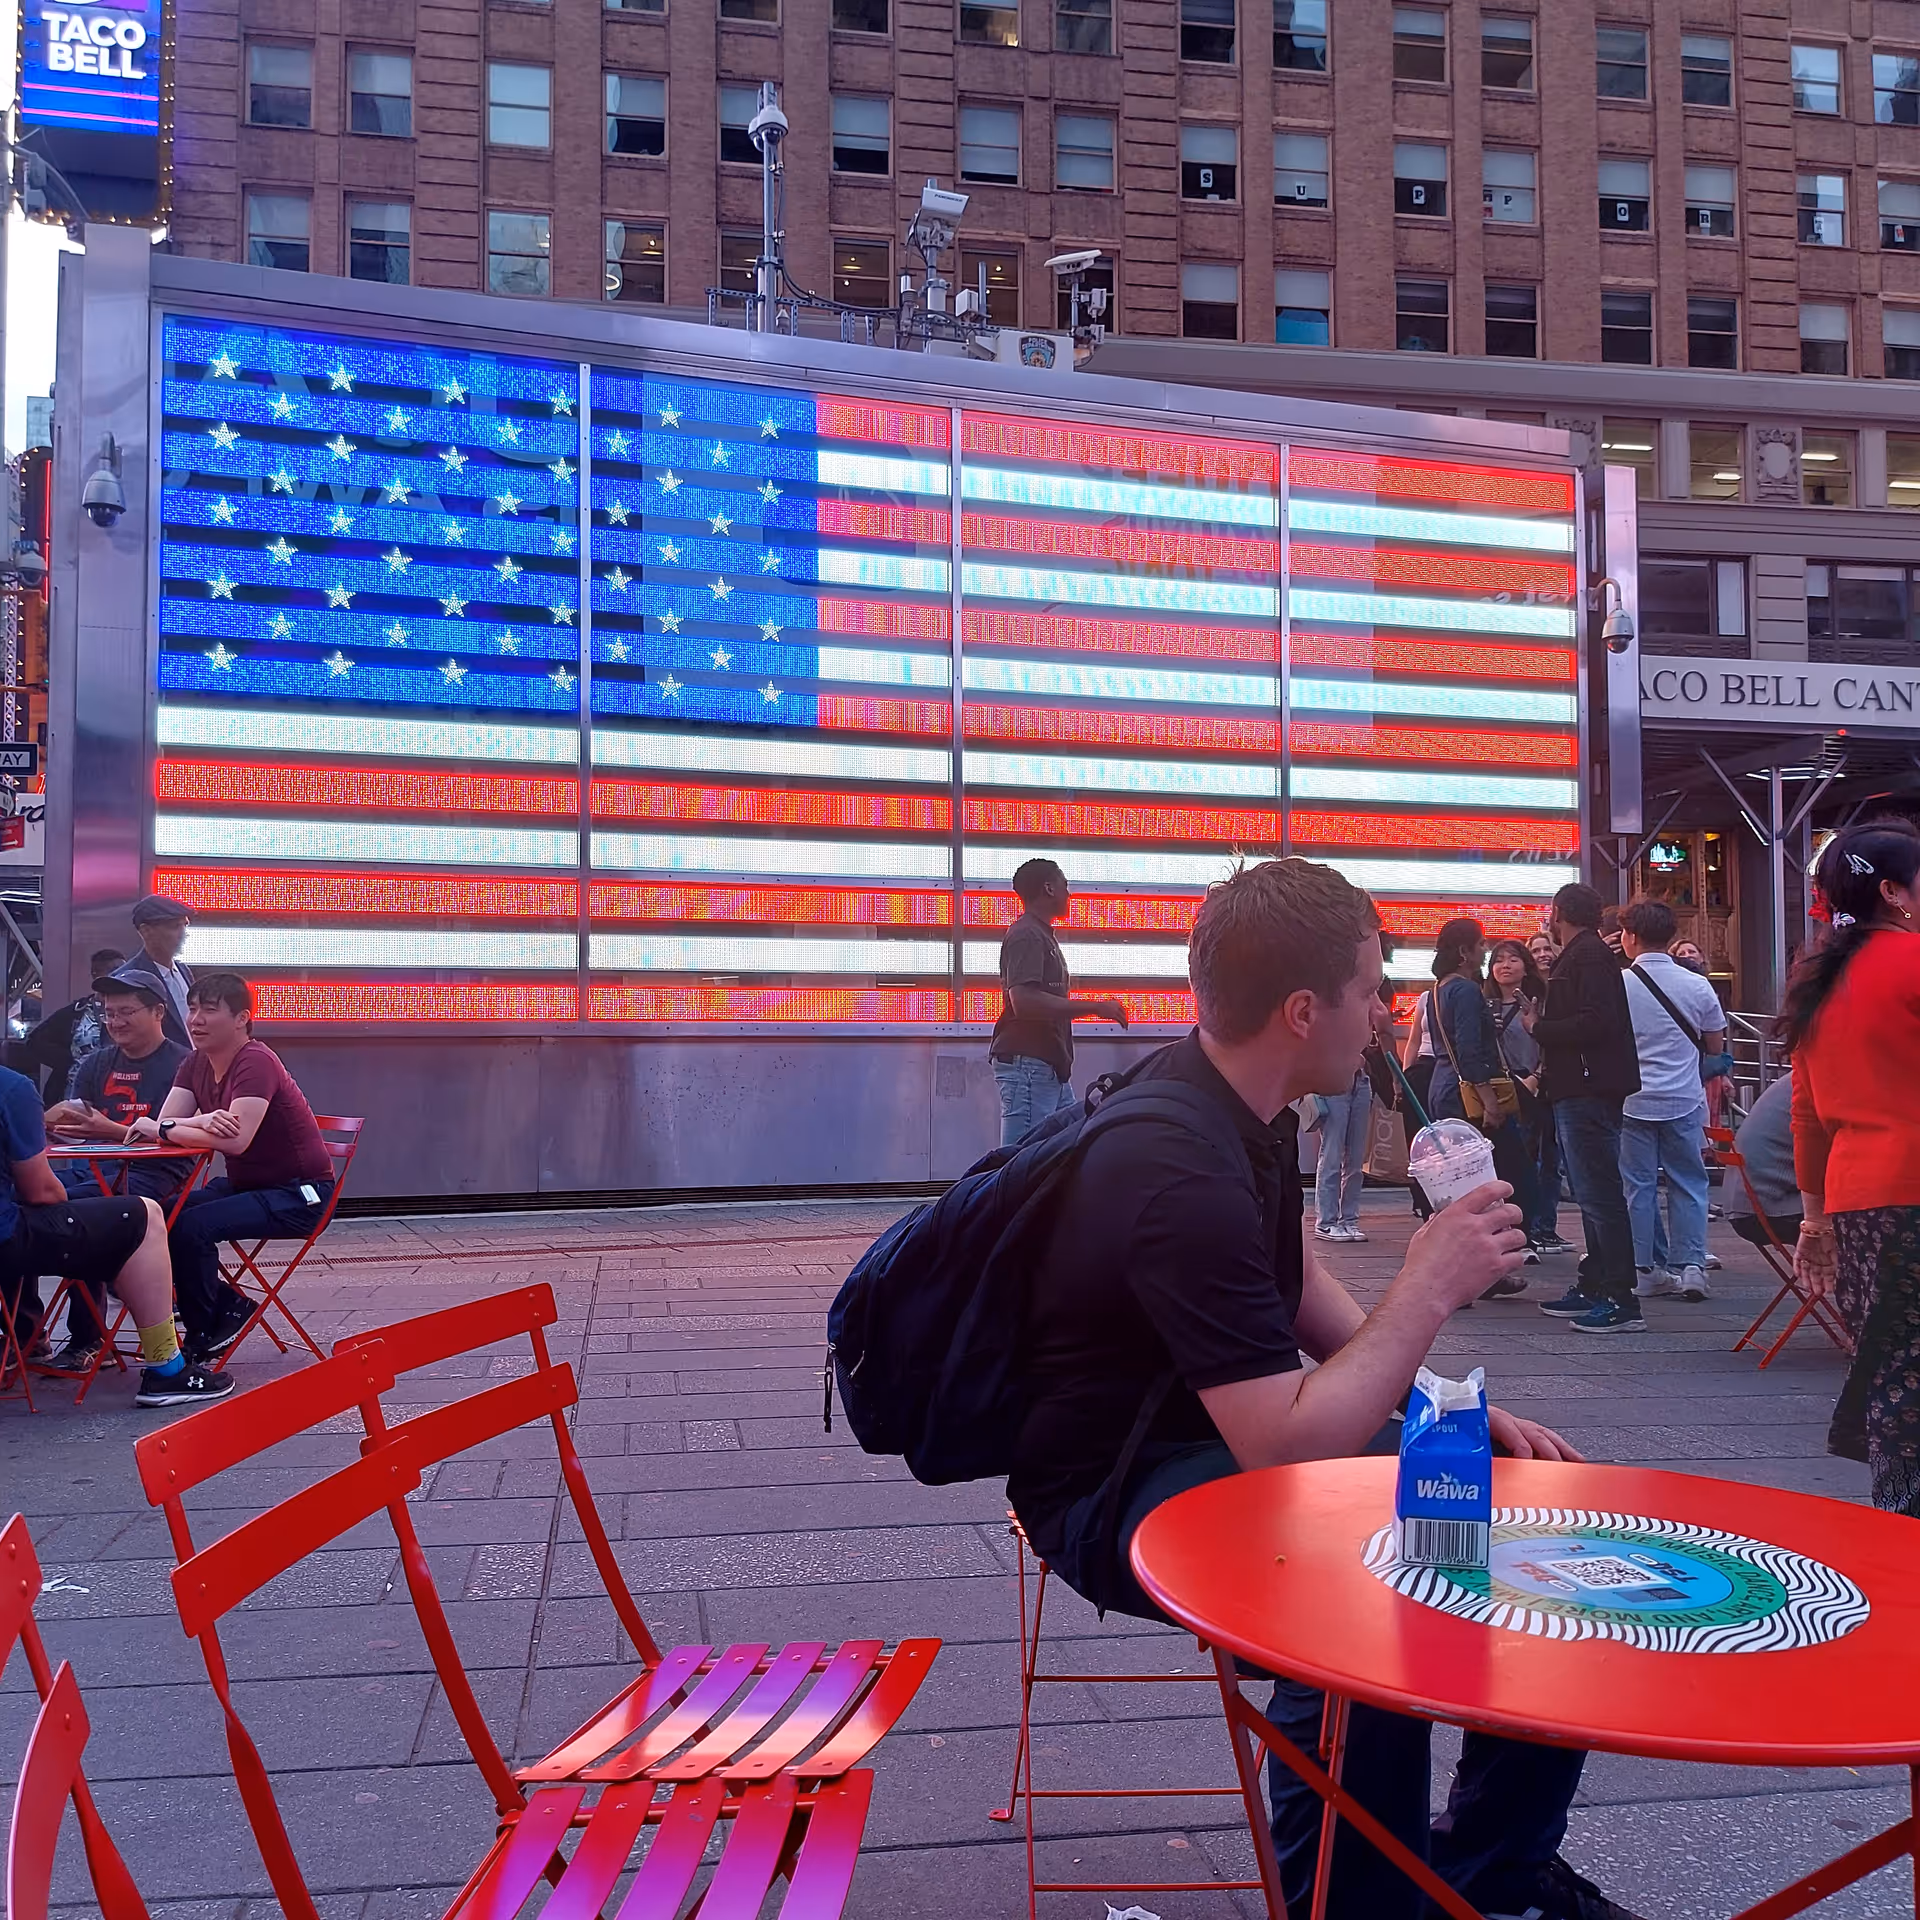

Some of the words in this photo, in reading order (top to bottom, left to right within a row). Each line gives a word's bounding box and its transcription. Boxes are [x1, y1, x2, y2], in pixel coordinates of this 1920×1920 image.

[41, 11, 147, 50] TACO
[48, 42, 146, 79] BELL
[1720, 672, 1820, 707] BELL
[0, 753, 23, 766] AY
[1417, 1479, 1479, 1500] Wawa
[1516, 1527, 1587, 1536] FREE
[1595, 1530, 1653, 1544] LIVE
[1544, 1602, 1644, 1623] MORE
[1652, 1612, 1716, 1624] AND
